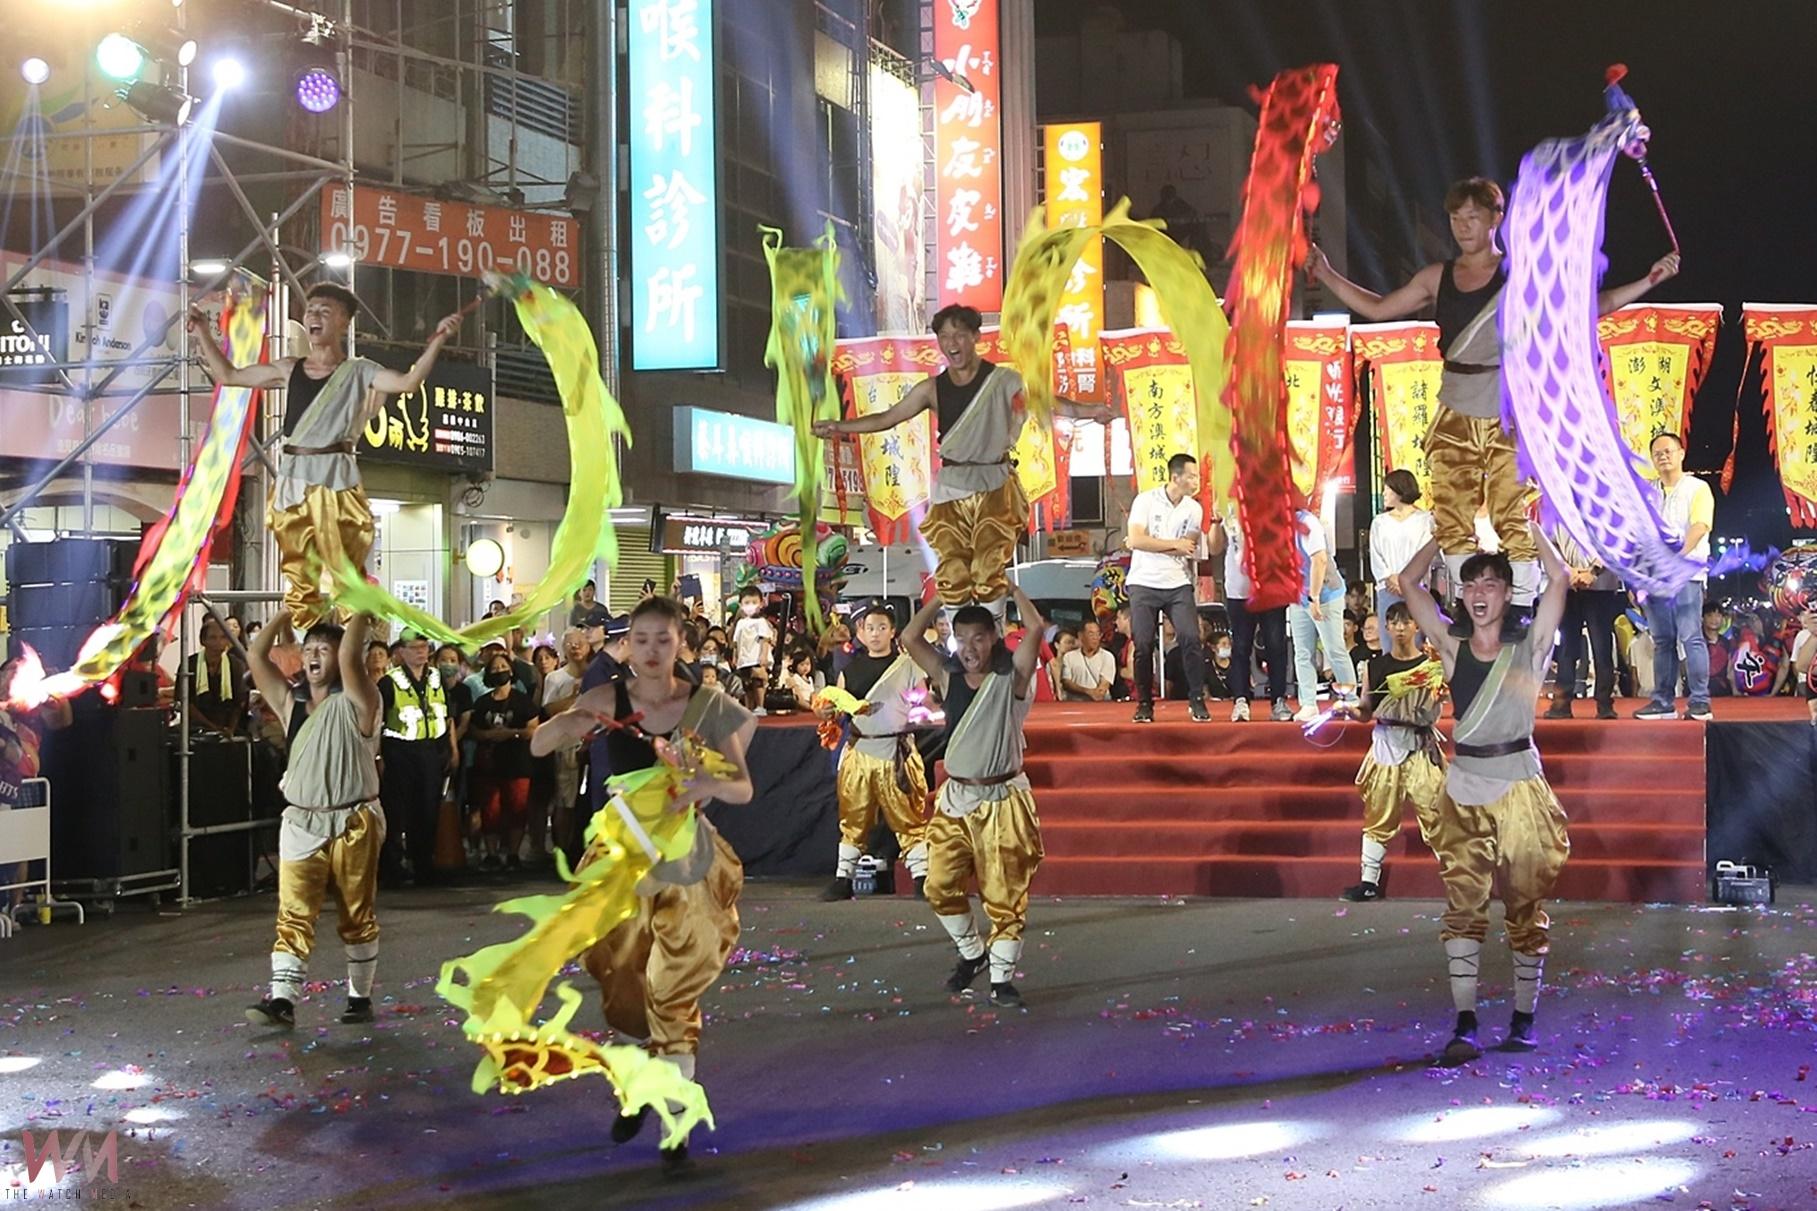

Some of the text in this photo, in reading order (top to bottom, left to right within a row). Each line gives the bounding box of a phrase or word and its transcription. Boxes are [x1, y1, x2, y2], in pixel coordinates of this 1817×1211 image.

[638, 0, 708, 343] 喉科診所
[331, 189, 568, 248] 廣告看板出租
[330, 221, 571, 284] 0977-190-088
[1628, 356, 1671, 375] 澎湖
[881, 434, 904, 487] 城隍
[1147, 378, 1168, 482] 南方澳城隍
